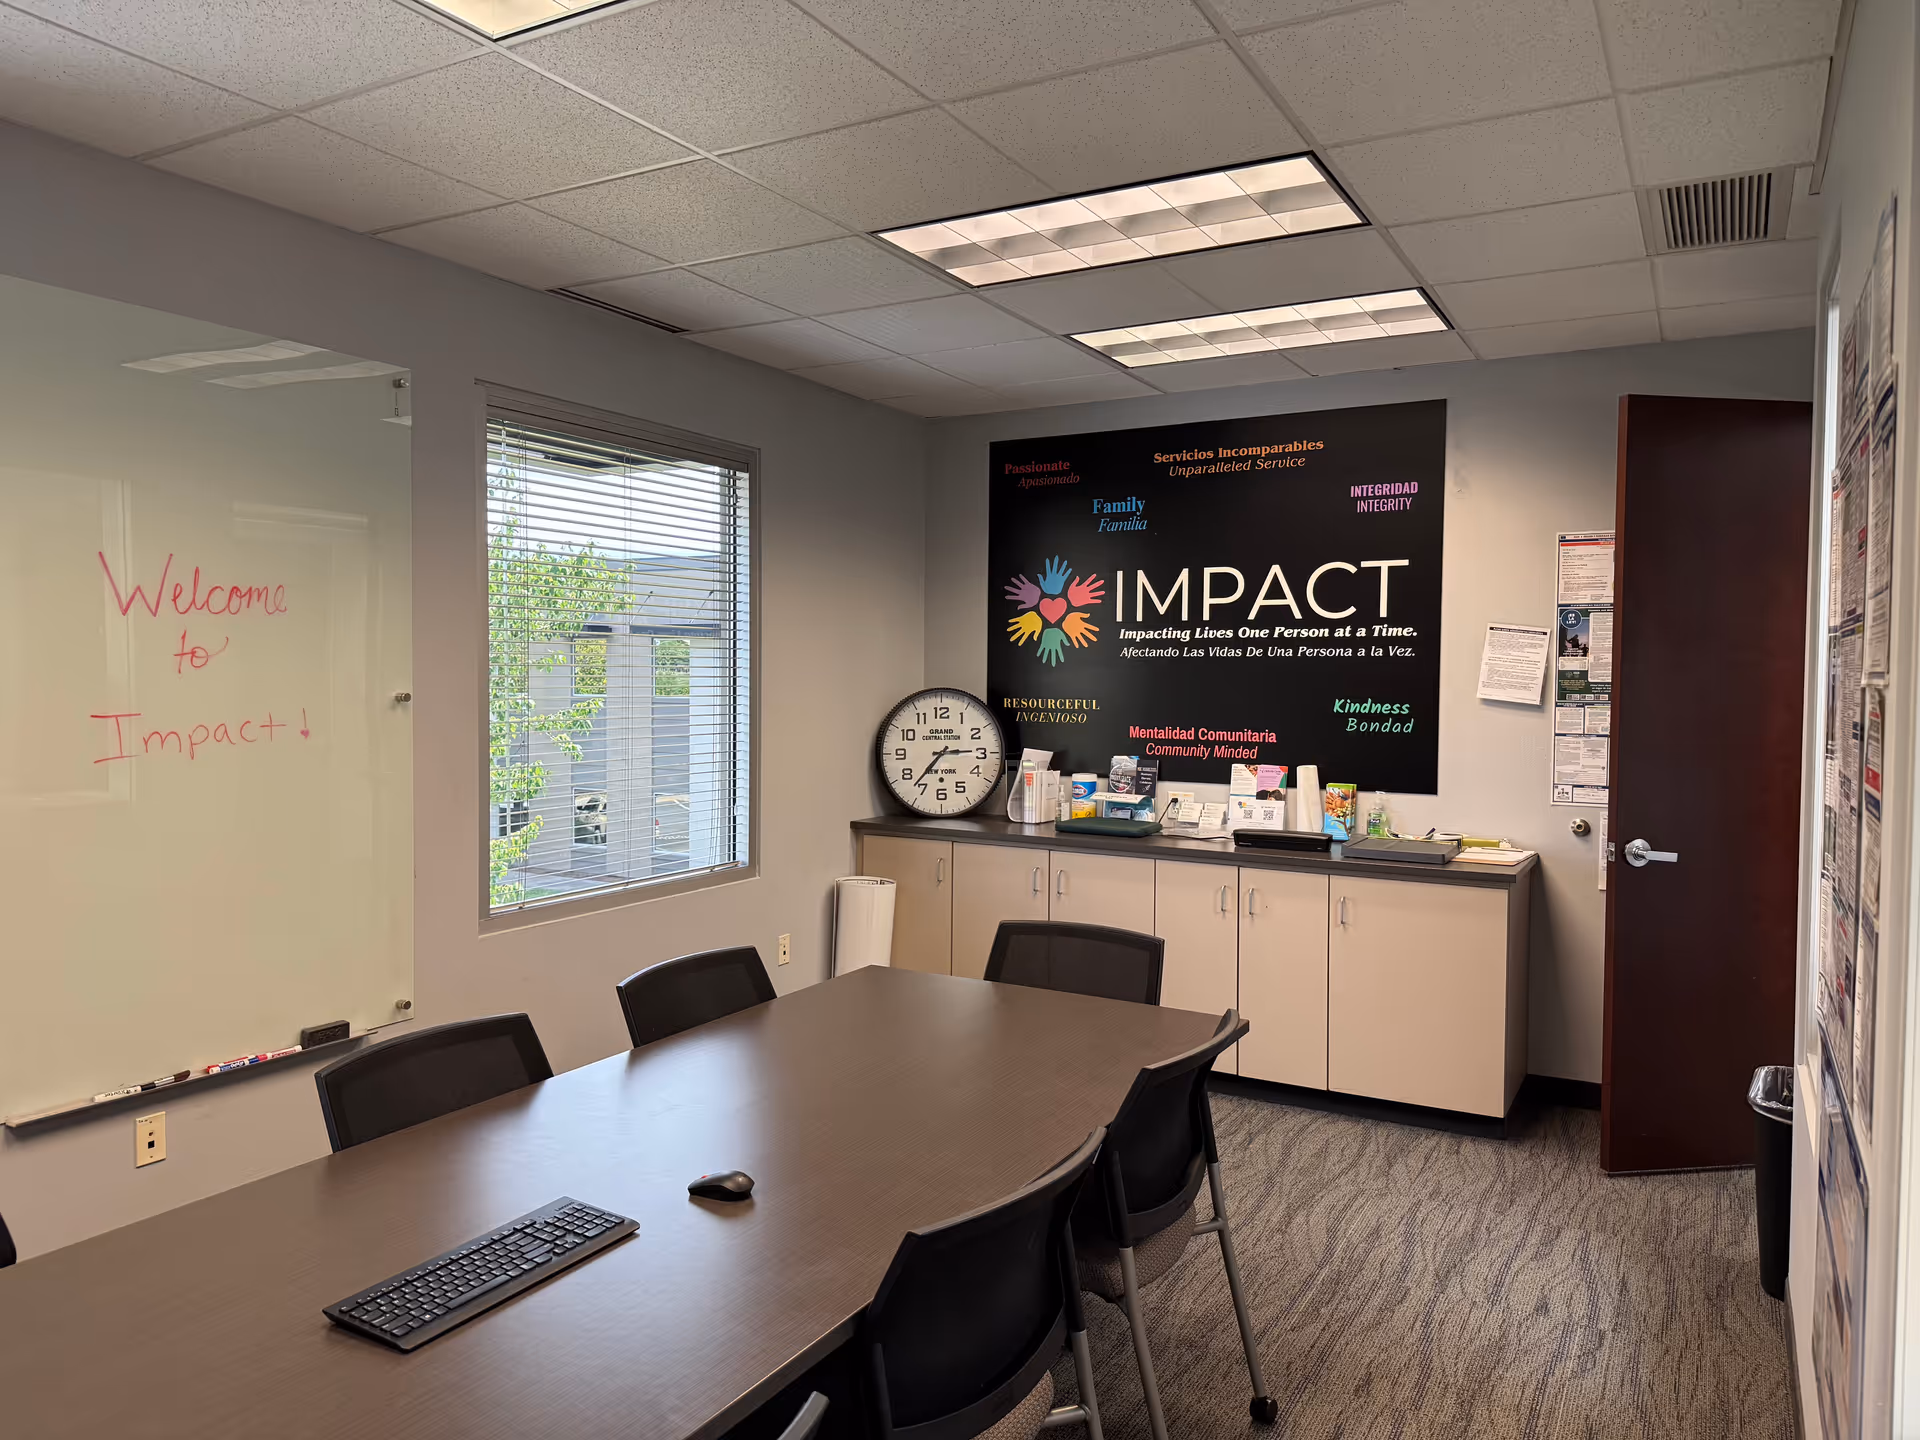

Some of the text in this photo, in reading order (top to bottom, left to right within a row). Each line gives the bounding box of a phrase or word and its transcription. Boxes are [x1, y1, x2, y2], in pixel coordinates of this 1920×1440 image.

[1153, 439, 1325, 464] Servicios Incomparables
[1005, 460, 1071, 476] Passionate
[1169, 456, 1306, 478] Unparalleled Service
[1016, 471, 1081, 490] Apasionado
[1350, 481, 1419, 498] INTEGRIDAD
[1092, 496, 1146, 516] Family
[1357, 497, 1413, 513] INTEGRITY
[1097, 515, 1148, 533] Familia
[98, 550, 287, 617] Welcome
[1115, 558, 1410, 623] IMPACT
[1118, 623, 1418, 643] Impacting Lives One Person at a Time.
[173, 629, 229, 674] to
[1119, 645, 1416, 659] Afectando Las Vidas De Una Persona a la Vez.
[1004, 697, 1100, 710] RESOURCEFUL
[1333, 697, 1411, 715] Kindness
[915, 712, 927, 725] 11
[933, 706, 950, 720] 12
[959, 711, 964, 725] 1
[1015, 711, 1087, 724] INGENIOSO
[1345, 717, 1414, 733] Bondad
[90, 707, 310, 764] Impact!
[900, 728, 916, 742] 10
[970, 727, 981, 740] 2
[1129, 725, 1277, 743] Mentalidad Comunitaria
[895, 748, 907, 761] 9
[975, 747, 987, 760] 3
[1145, 742, 1259, 761] Community Minded
[901, 767, 913, 781] 8
[969, 764, 982, 778] 4
[918, 783, 928, 796] 7
[936, 788, 948, 801] 6
[954, 781, 966, 794] 5
